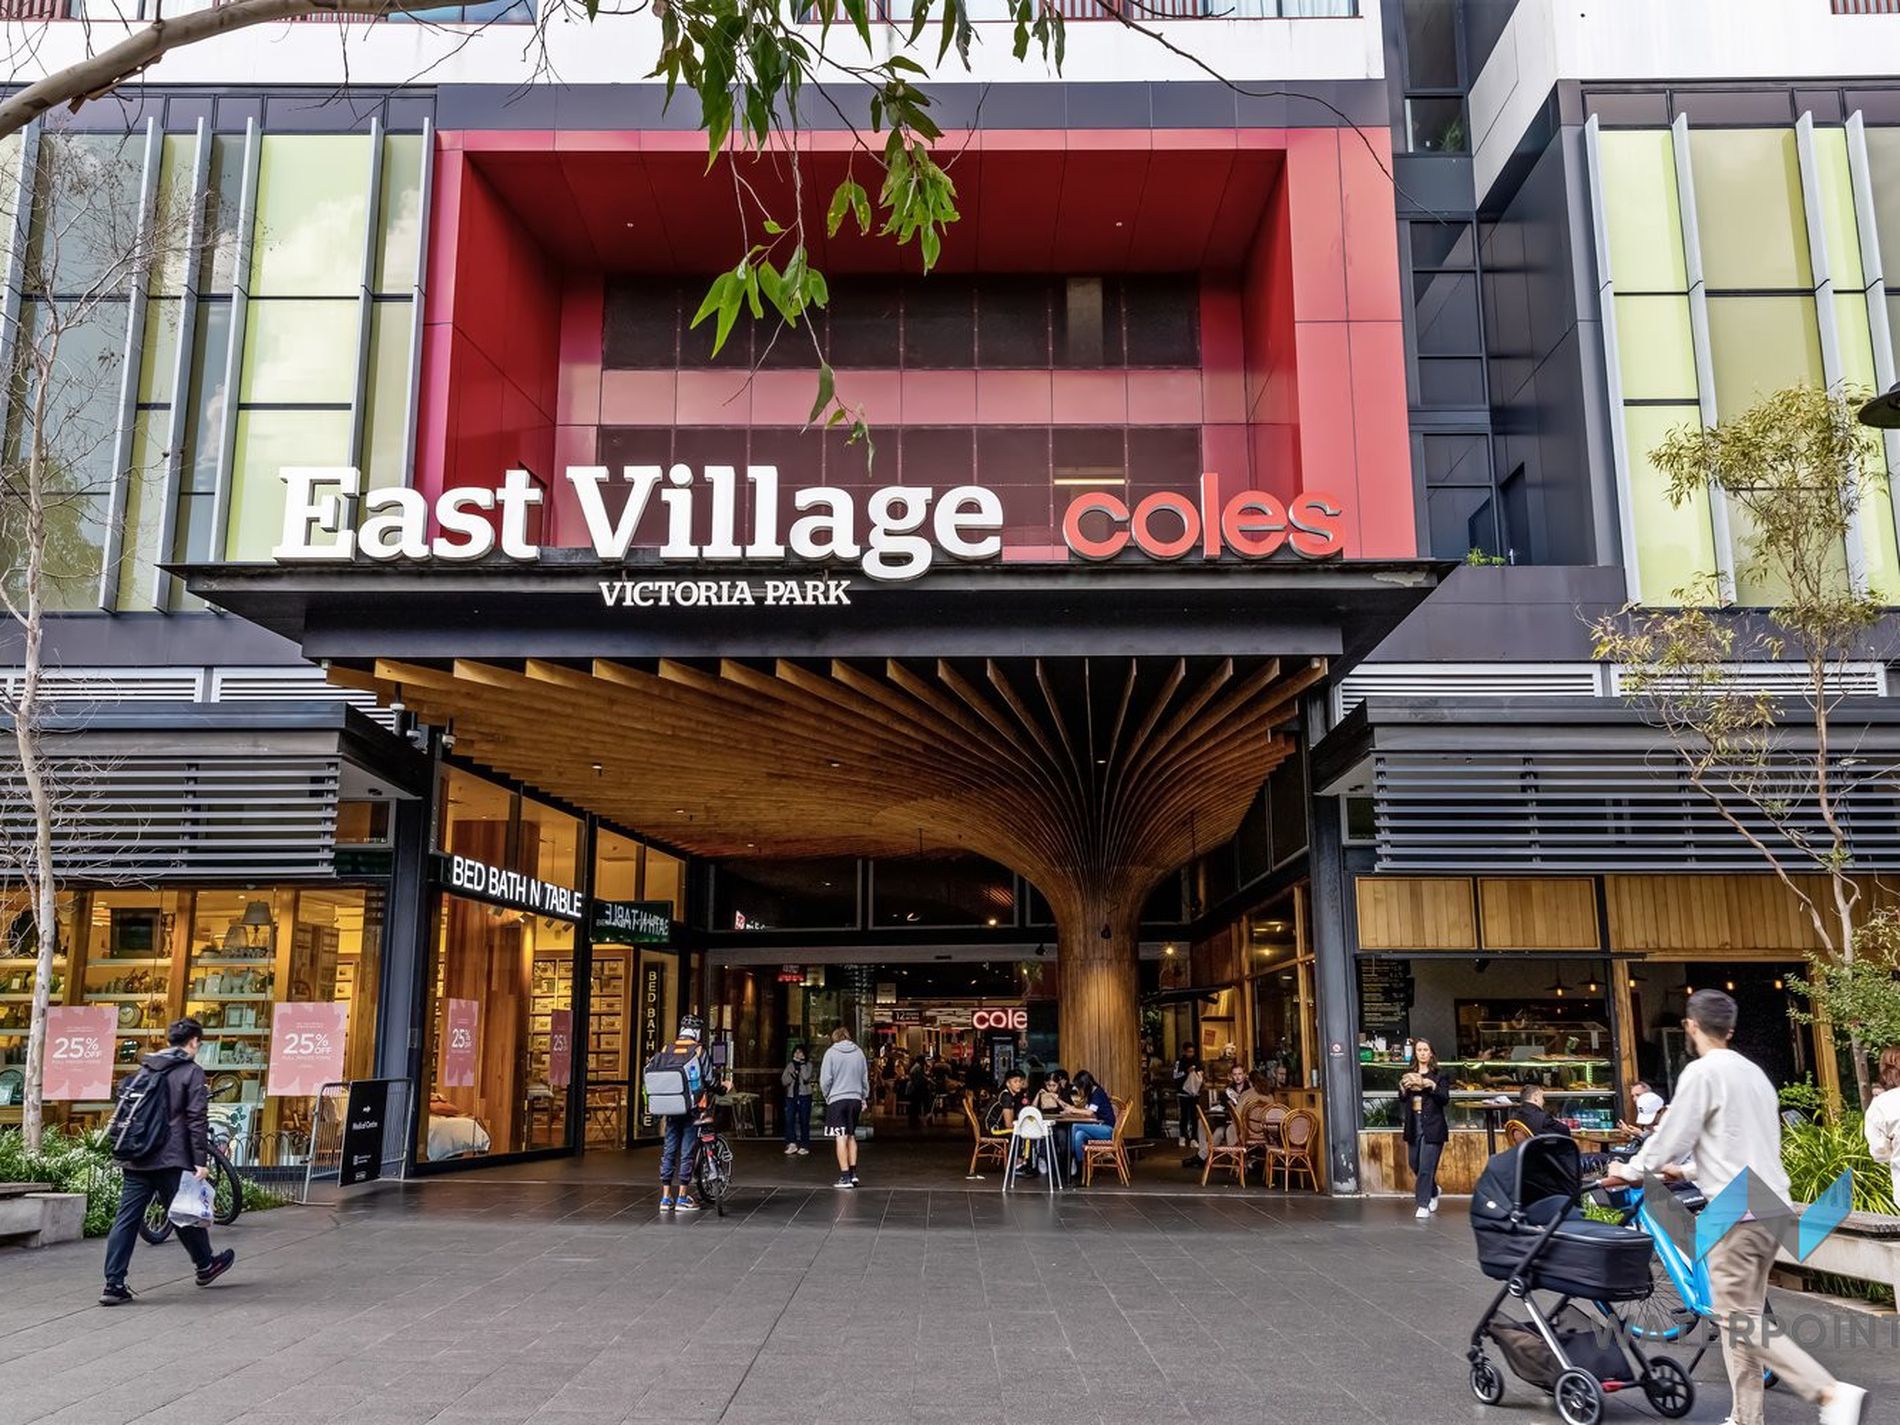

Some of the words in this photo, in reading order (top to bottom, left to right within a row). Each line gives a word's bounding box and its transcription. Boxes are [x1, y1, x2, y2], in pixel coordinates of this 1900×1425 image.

[272, 466, 544, 562] East
[566, 463, 1003, 581] Village
[1063, 473, 1345, 561] coles
[599, 581, 755, 606] VICTORIA
[764, 581, 851, 605] PARK
[452, 855, 486, 891] BED
[489, 866, 526, 903] BATH
[530, 879, 540, 907] N
[545, 882, 582, 918] TABLE
[647, 971, 657, 1003] BED
[646, 1008, 656, 1050] BATH
[972, 1010, 1028, 1029] cole
[52, 1037, 99, 1058] 25%
[283, 1033, 329, 1054] 25%
[314, 1047, 332, 1055] OFF
